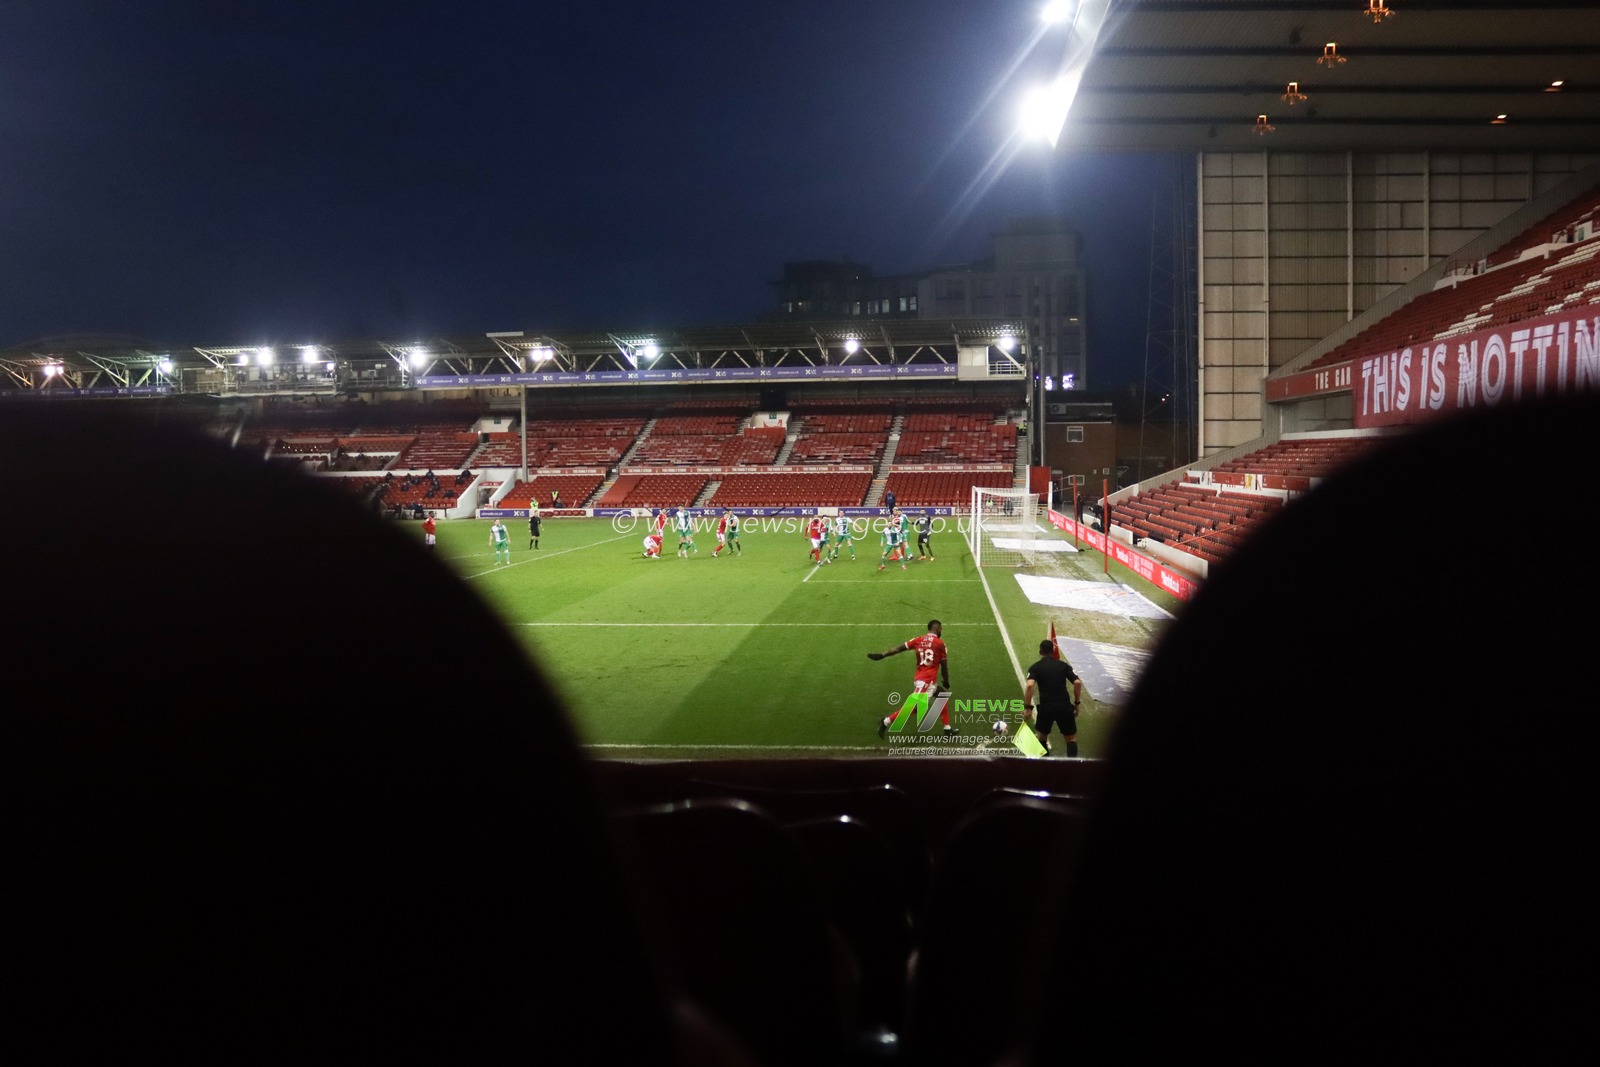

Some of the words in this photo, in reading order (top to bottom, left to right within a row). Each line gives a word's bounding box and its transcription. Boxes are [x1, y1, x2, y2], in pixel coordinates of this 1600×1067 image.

[1315, 371, 1329, 391] THE
[1361, 347, 1412, 416] THIS
[1419, 343, 1447, 410] IS
[918, 648, 934, 666] 18
